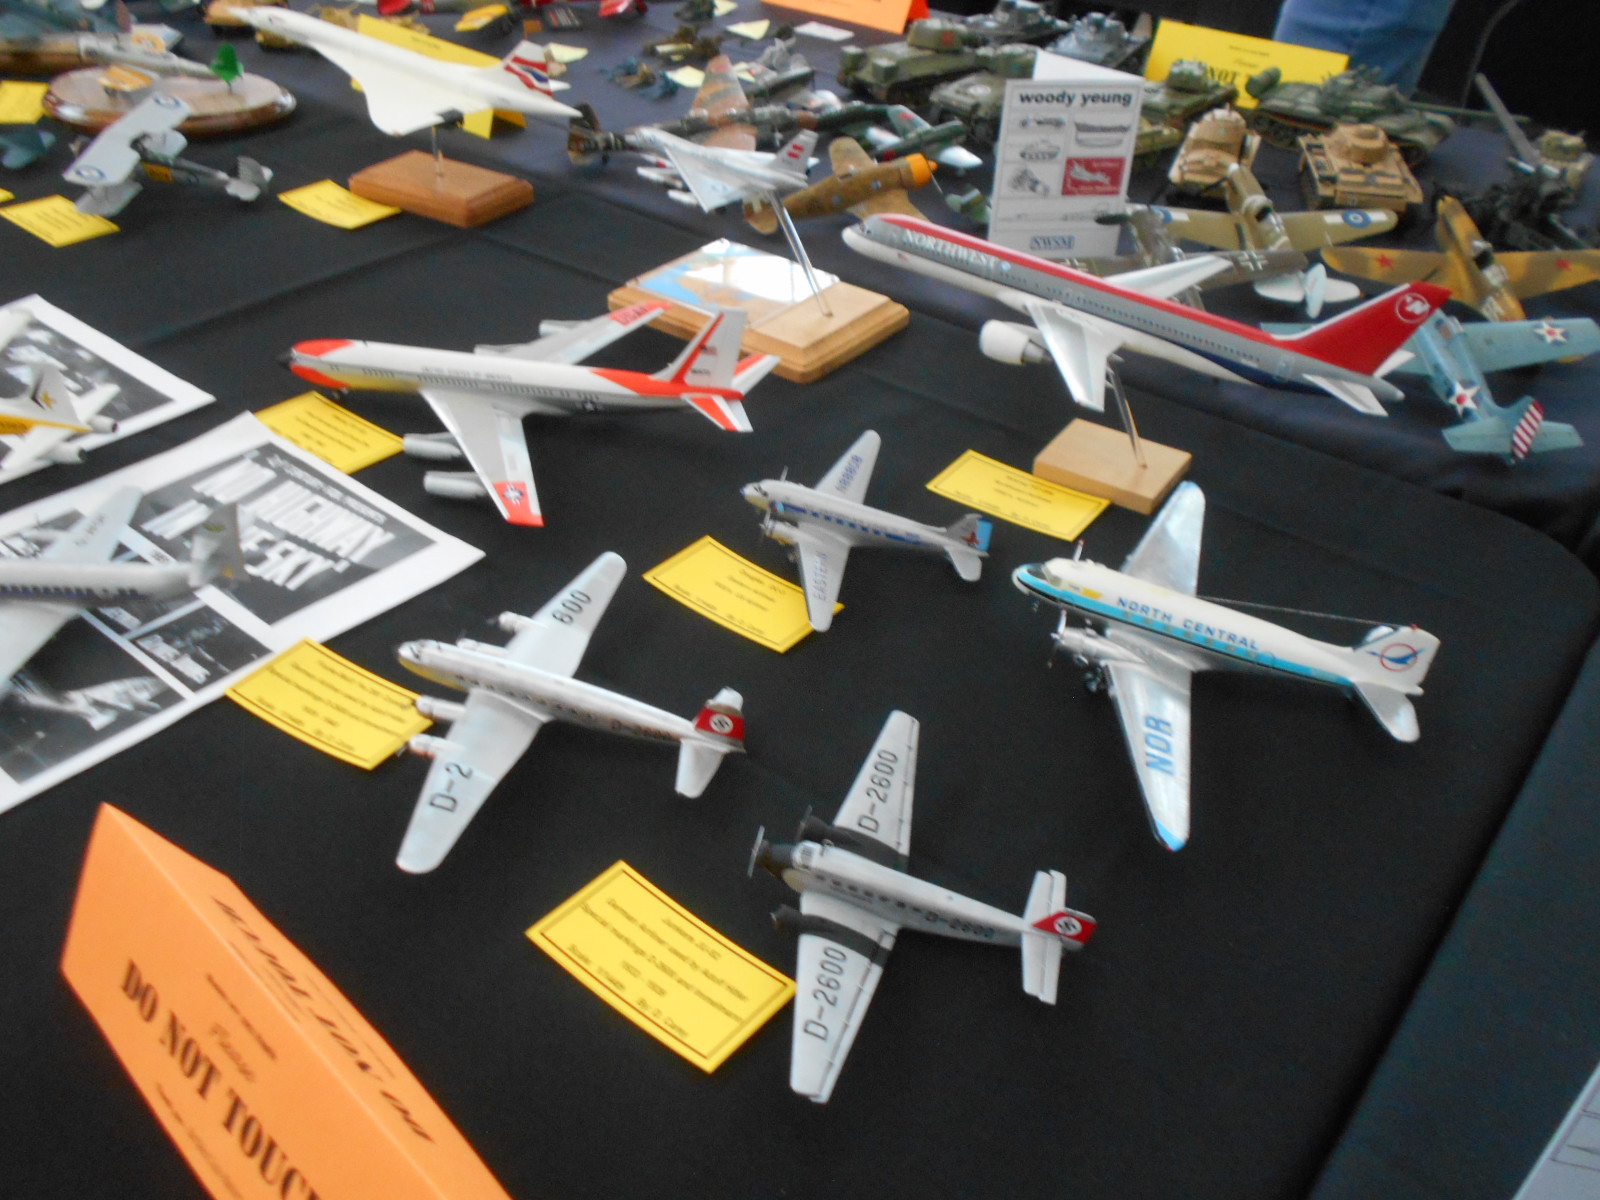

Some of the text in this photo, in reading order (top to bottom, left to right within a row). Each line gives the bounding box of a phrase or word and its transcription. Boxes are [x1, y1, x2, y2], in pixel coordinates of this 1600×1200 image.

[1019, 90, 1133, 107] woody yeung
[905, 228, 996, 270] NORTHWEST
[1117, 597, 1259, 650] NORTH CENTRAL
[430, 590, 592, 813] D-2 600
[1145, 715, 1175, 776] NOR
[857, 750, 899, 835] D-2600
[803, 947, 847, 1041] D-2600
[121, 958, 158, 1022] DO
[159, 1008, 222, 1100] NOT
[222, 1087, 321, 1200] TOUC
